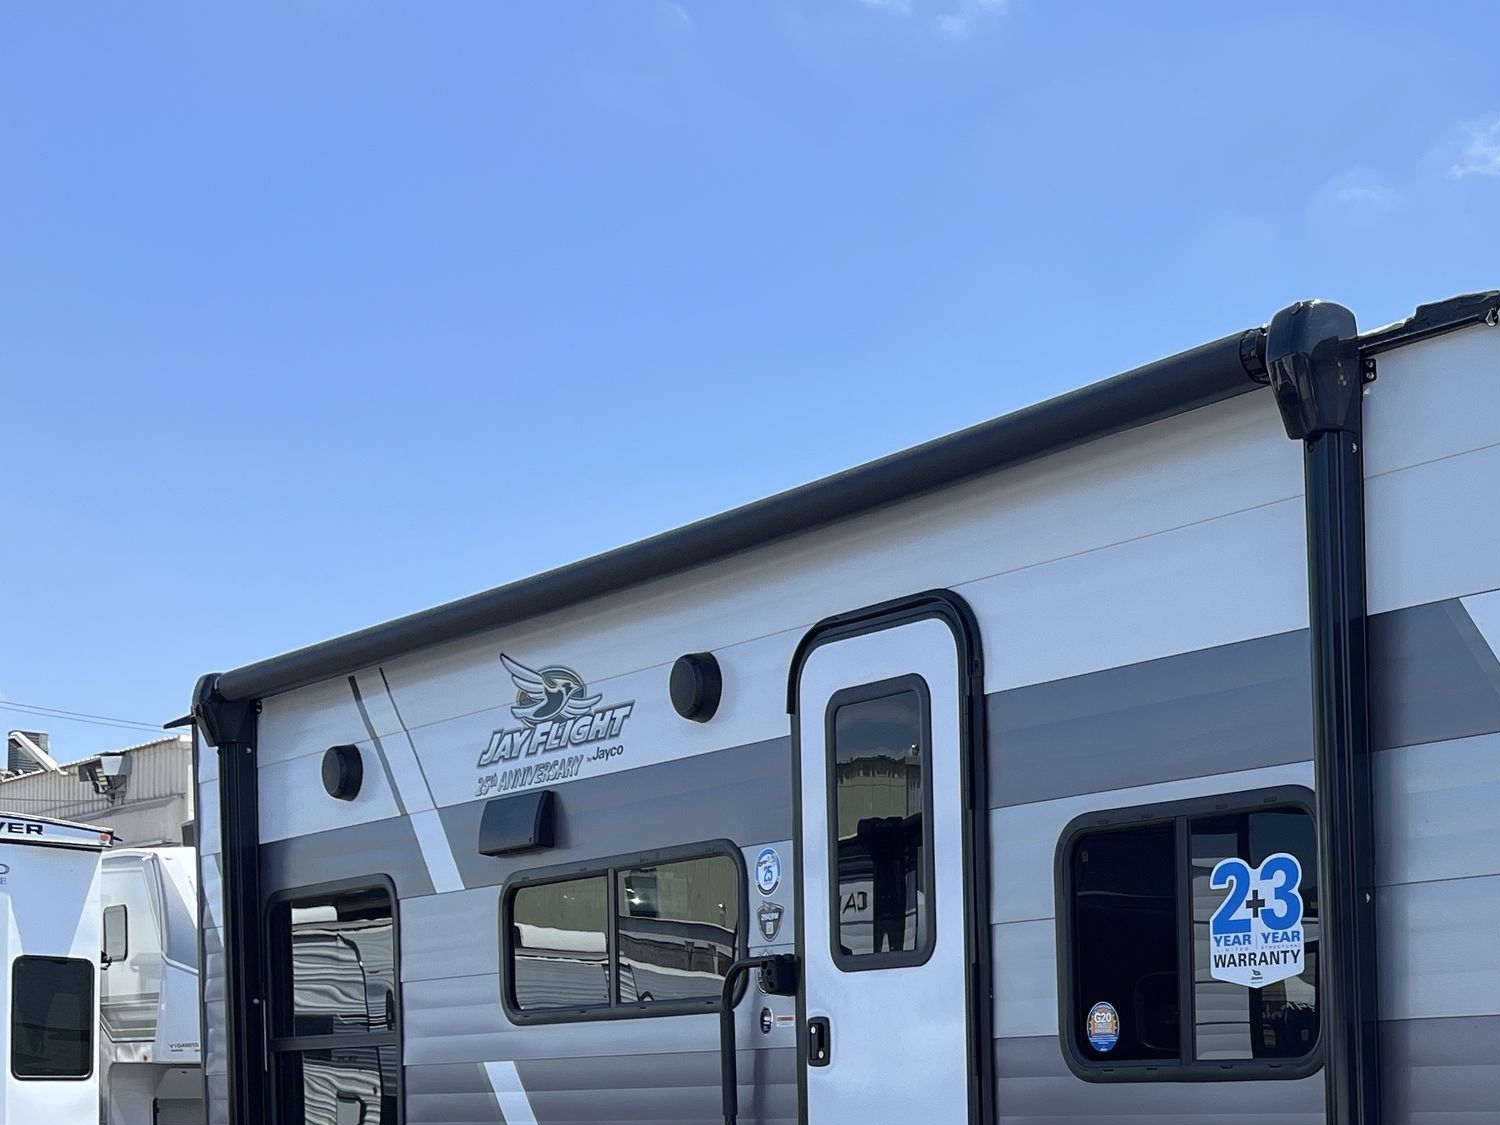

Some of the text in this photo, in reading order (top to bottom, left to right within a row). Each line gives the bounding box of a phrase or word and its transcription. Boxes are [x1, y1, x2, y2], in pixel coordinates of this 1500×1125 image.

[477, 700, 635, 769] JAY FLIGHT
[592, 745, 624, 762] Jayco
[475, 754, 584, 797] 25th ANNIVERSARY
[1213, 930, 1301, 947] YEAR YEAR
[1213, 949, 1301, 968] WARRANTY
[1094, 1012, 1112, 1023] G20
